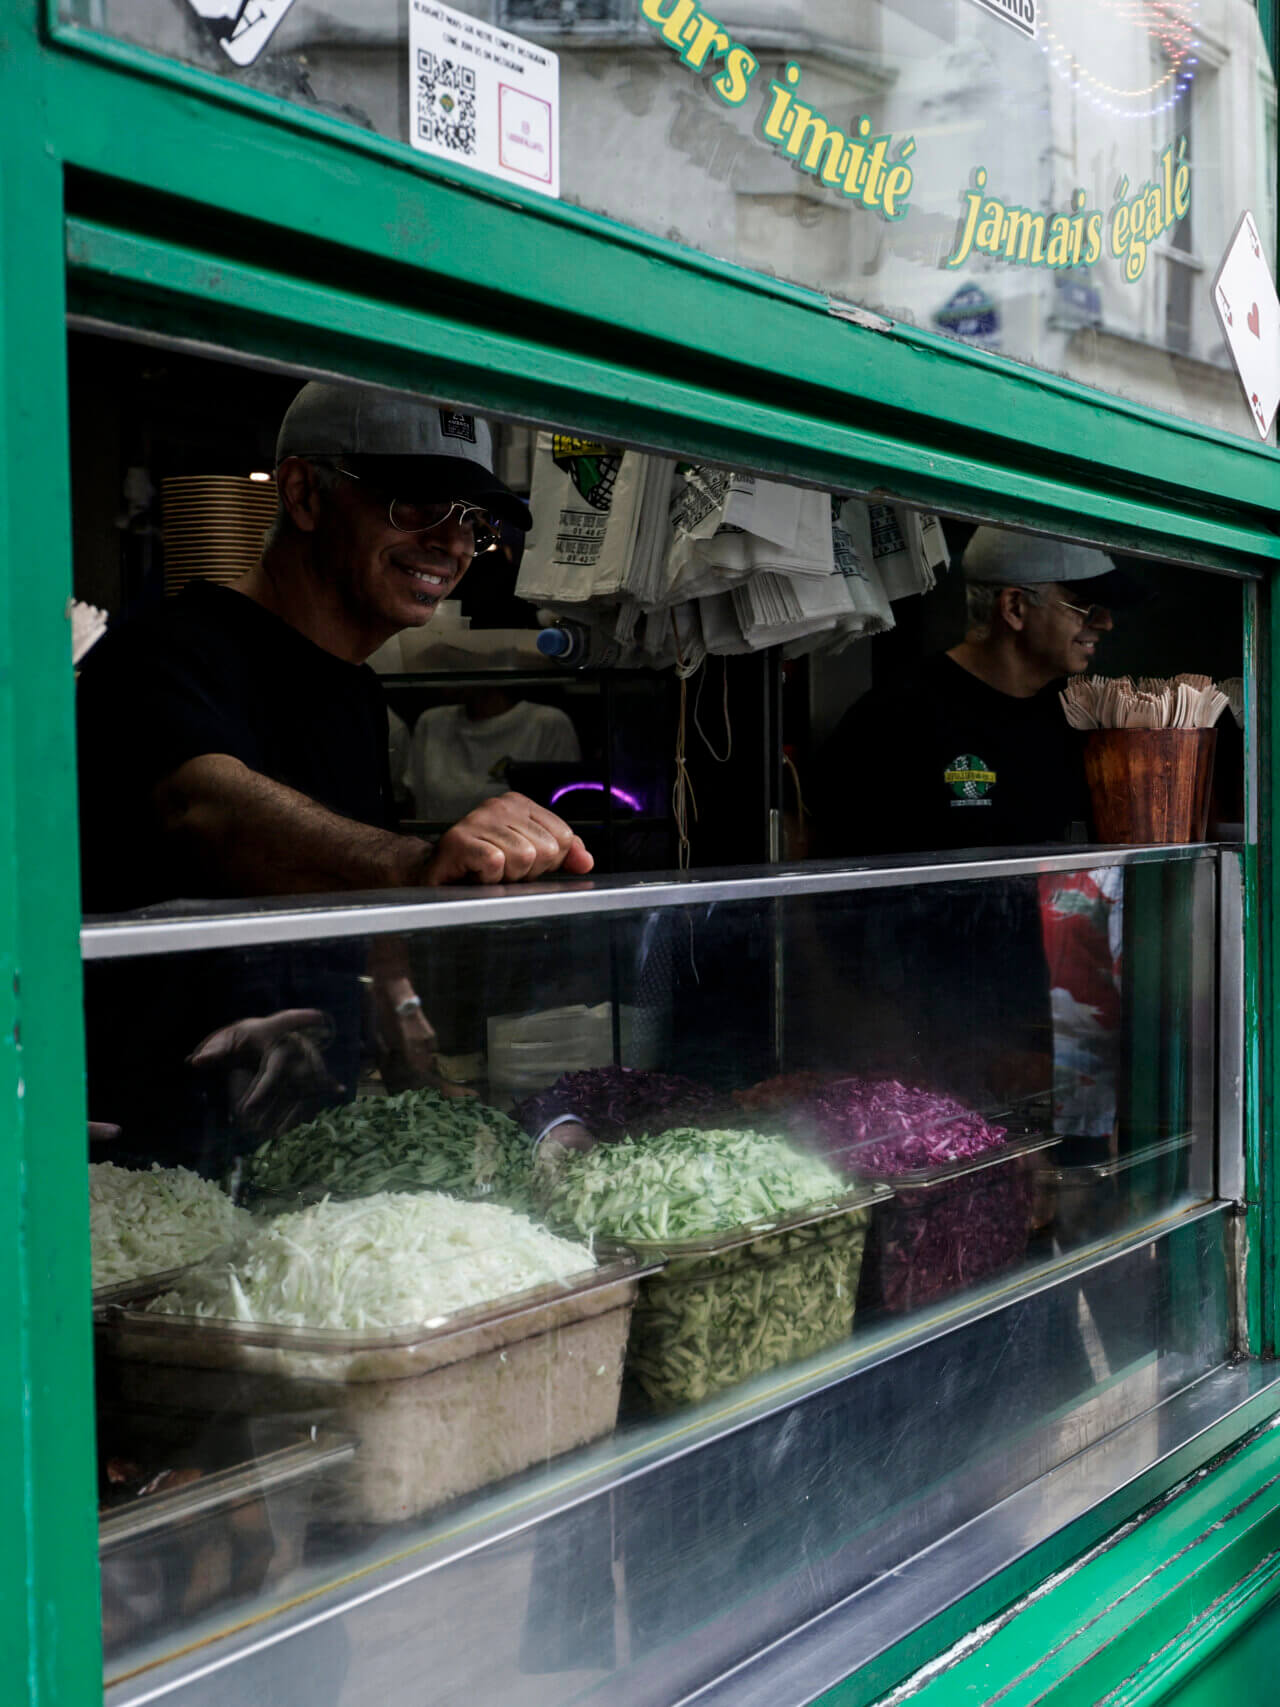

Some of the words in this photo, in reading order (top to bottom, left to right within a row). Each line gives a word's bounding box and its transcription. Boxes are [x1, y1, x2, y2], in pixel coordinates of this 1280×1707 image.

[762, 61, 917, 221] imité
[946, 166, 1102, 269] jamais
[1111, 136, 1192, 281] égalé
